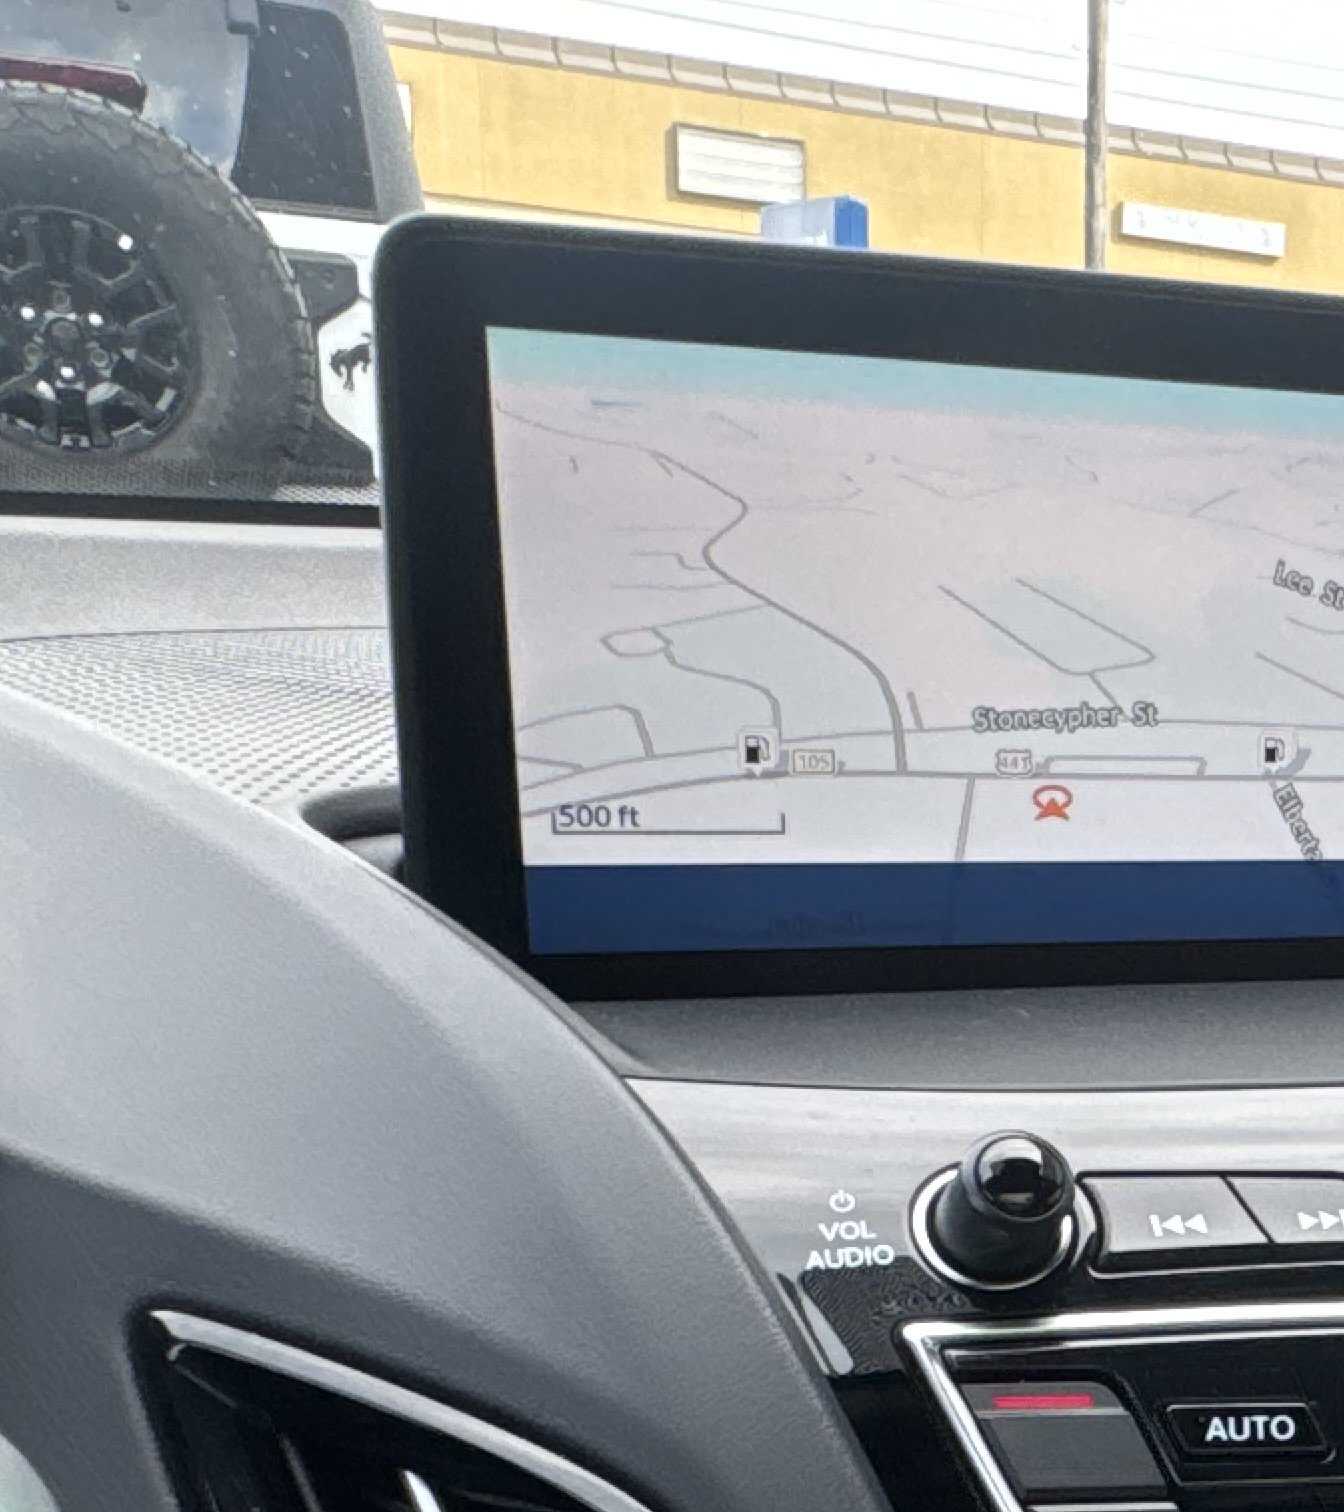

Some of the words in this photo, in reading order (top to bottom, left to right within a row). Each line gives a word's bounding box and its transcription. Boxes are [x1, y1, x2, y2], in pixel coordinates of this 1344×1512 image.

[1273, 557, 1314, 596] Lee
[972, 701, 1123, 734] Stonecypher
[1131, 700, 1159, 727] St
[797, 753, 830, 770] 105
[558, 805, 611, 828] 500
[617, 805, 640, 828] ft
[817, 1220, 878, 1242] VOL
[804, 1244, 895, 1270] AUDIO
[1204, 1414, 1296, 1442] AUTO
